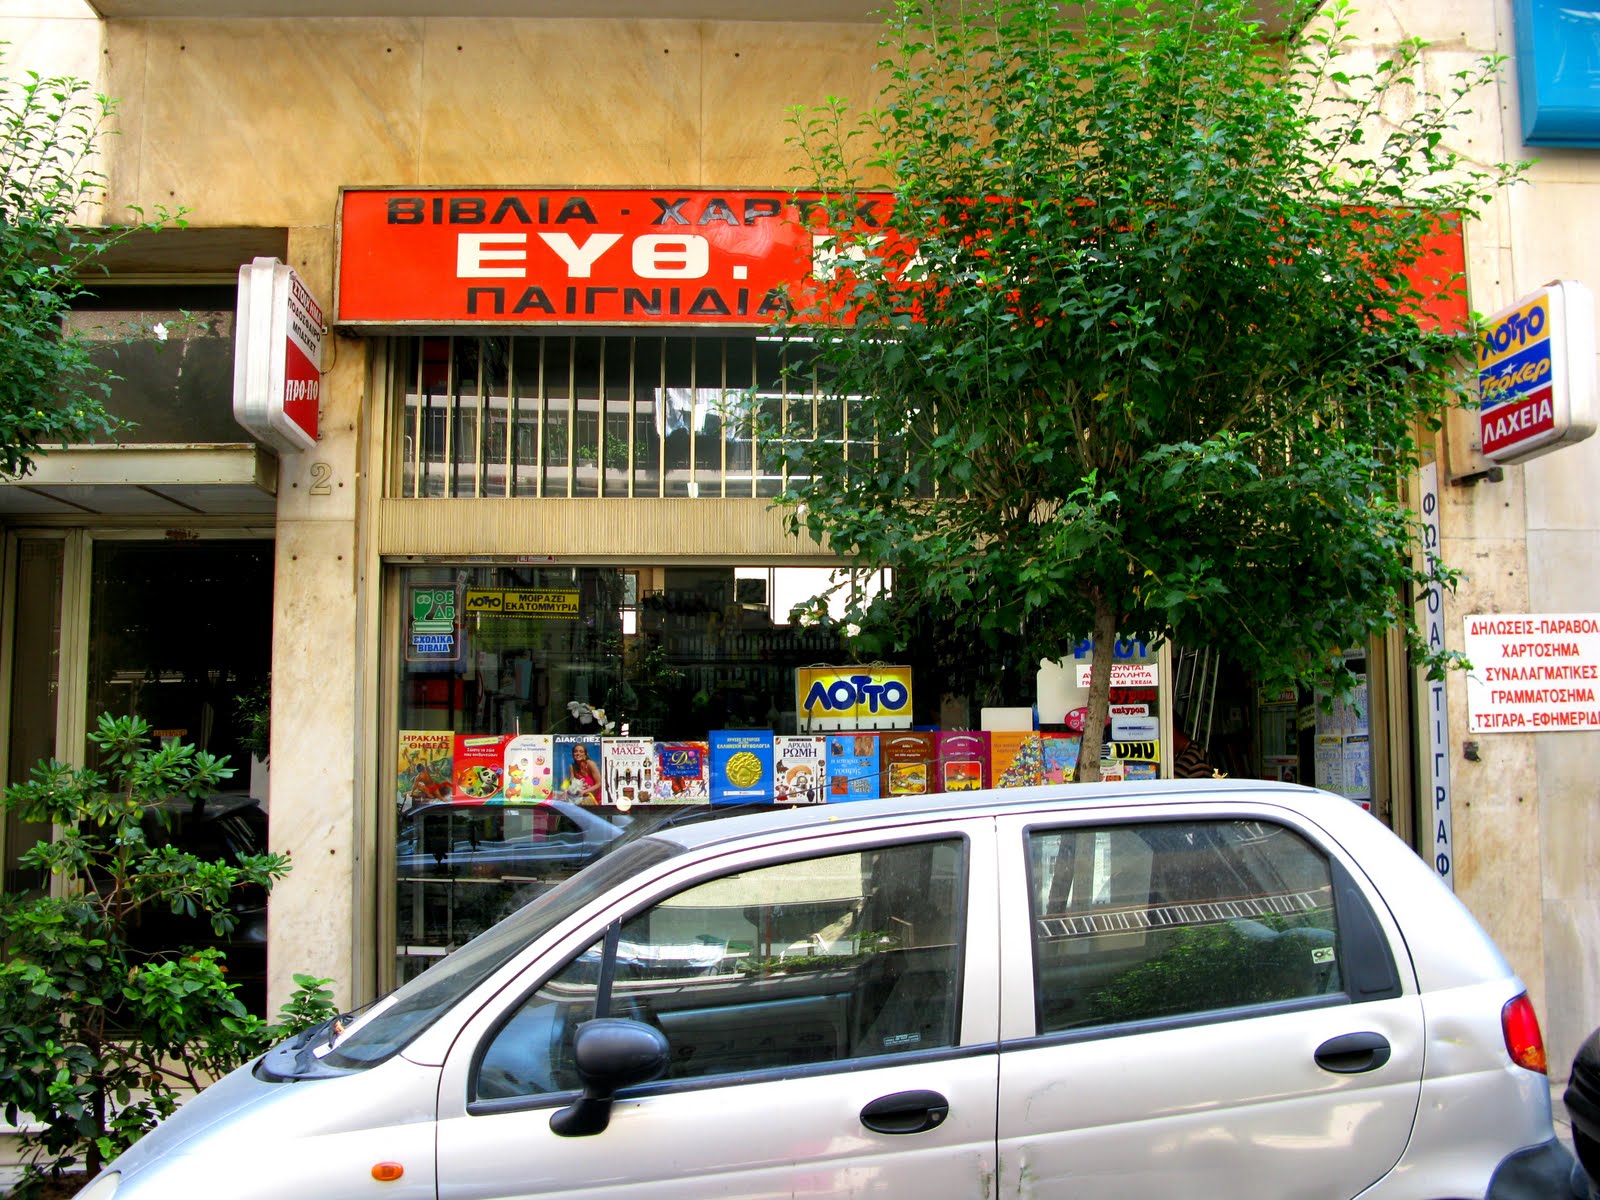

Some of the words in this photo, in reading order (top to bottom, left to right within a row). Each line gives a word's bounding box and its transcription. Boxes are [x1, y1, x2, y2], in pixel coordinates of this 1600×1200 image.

[387, 196, 598, 226] ΒΙΒΛΙΑ
[455, 232, 748, 280] ΕΥΘ.
[466, 286, 796, 316] ΠΑΙΓΝΙΔΙΑ
[287, 297, 321, 342] ΠΟΔΟΣΦΑΙΡΟ
[292, 320, 317, 356] ΜΠΑΣΚΕΤ
[1481, 305, 1546, 361] ΛΟΤΤΟ
[285, 379, 319, 401] ΠΡΟ-ΠΟ
[1483, 398, 1553, 445] ΛΑΧΕΙΑ
[309, 462, 333, 496] 2
[518, 593, 567, 603] ΜΟΙΡΑΖΕΙ
[505, 602, 578, 612] ΕΚΑΤΟΜΜΥΡΙΑ
[1470, 619, 1600, 636] ΔΗΛΩΣΕΙΣ-ΠΑΡΑΒΟΛ
[413, 635, 454, 645] ΣΧΟΛΙΚΑ
[417, 644, 450, 653] ΒΙΒΛΙΑ
[1501, 643, 1580, 658] ΧΑΡΤΟΣΗΜΑ
[1486, 665, 1599, 682] ΣΥΝΑΛΑΓΜΑΤΙΚΕΣ
[803, 675, 908, 714] ΛΟΤΤΟ
[1491, 688, 1595, 704] ΓΡΑΜΜΑΤΟΣΗΜΑ
[1111, 706, 1146, 715] entypon
[1475, 711, 1600, 728] ΤΣΙΓΑΡΑ-ΕΦΗΜΕΡΙΔ
[409, 742, 451, 750] ΘΗΣΕΑΣ
[611, 747, 646, 755] ΜΑΧΕΣ
[782, 748, 818, 758] ΡΩΜΗ
[1114, 742, 1155, 759] UHU
